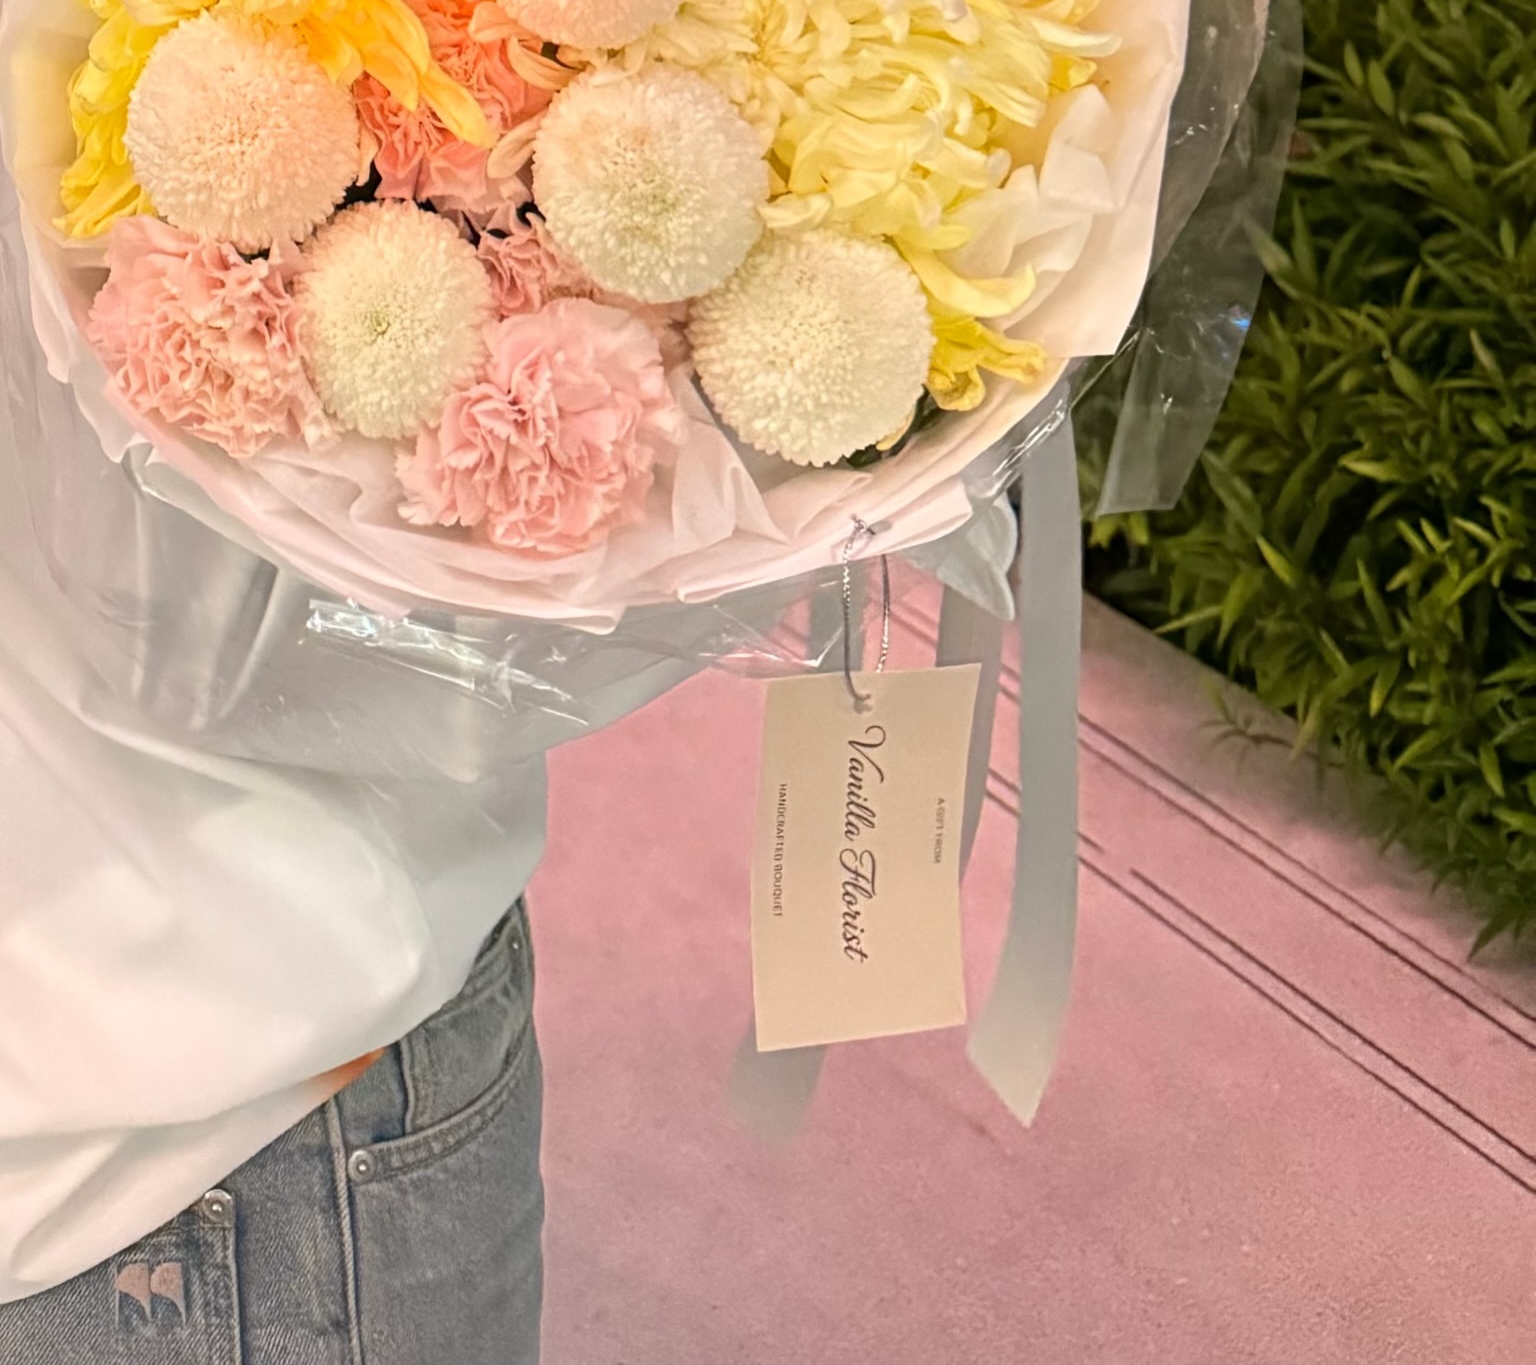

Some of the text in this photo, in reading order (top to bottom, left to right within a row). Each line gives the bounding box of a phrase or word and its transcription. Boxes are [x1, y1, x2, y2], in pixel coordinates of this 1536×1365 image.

[772, 784, 787, 917] HANDCRAFTED BOUQUET
[839, 725, 886, 962] Vanilla Florist
